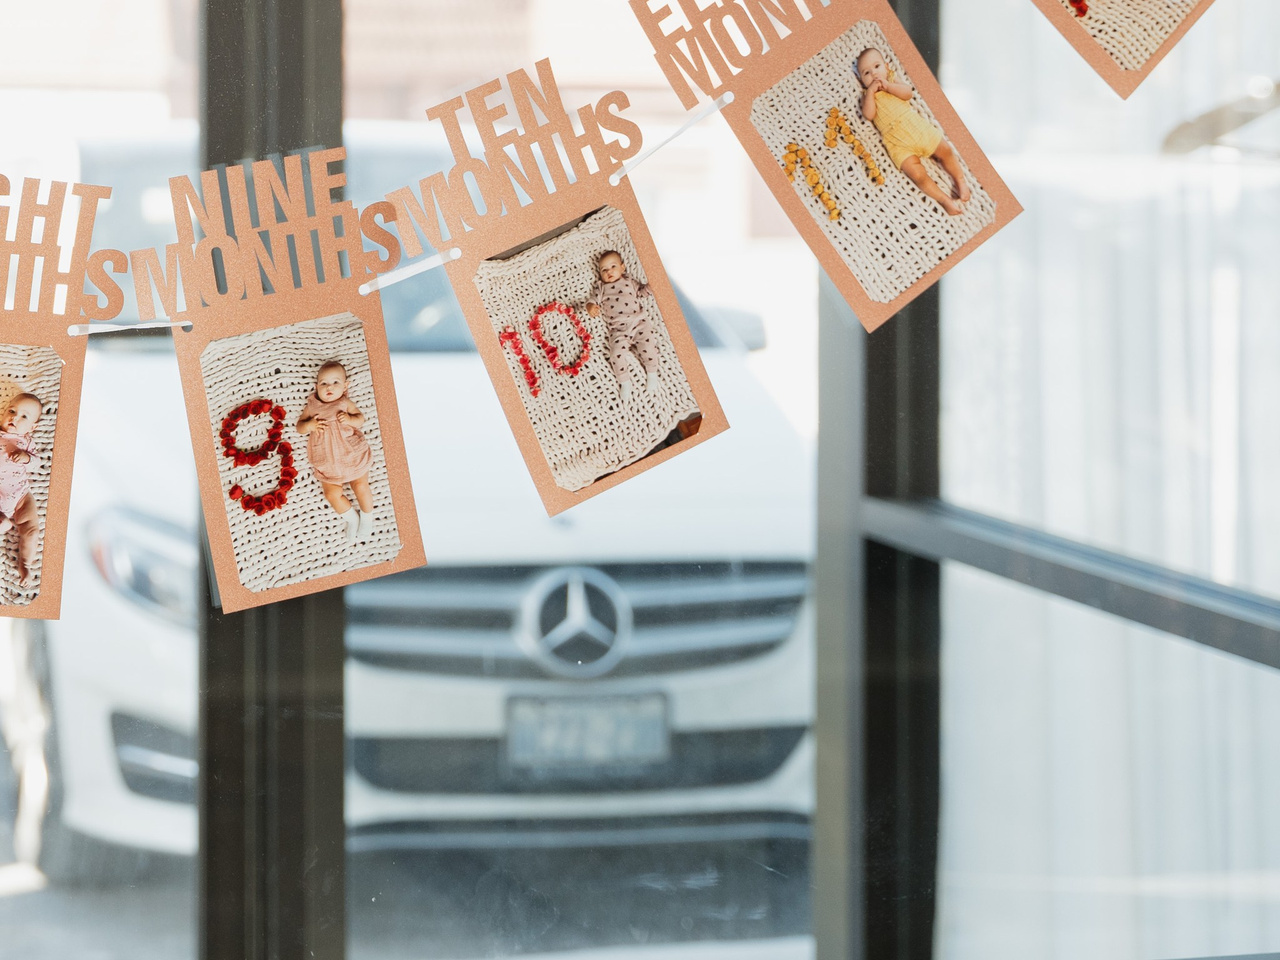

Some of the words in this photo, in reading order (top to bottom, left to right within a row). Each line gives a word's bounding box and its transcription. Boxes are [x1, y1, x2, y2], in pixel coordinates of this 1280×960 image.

[425, 56, 570, 168] TEN
[168, 146, 347, 245] NINE
[385, 89, 643, 259] MONTHS
[130, 200, 401, 321] MONTHS
